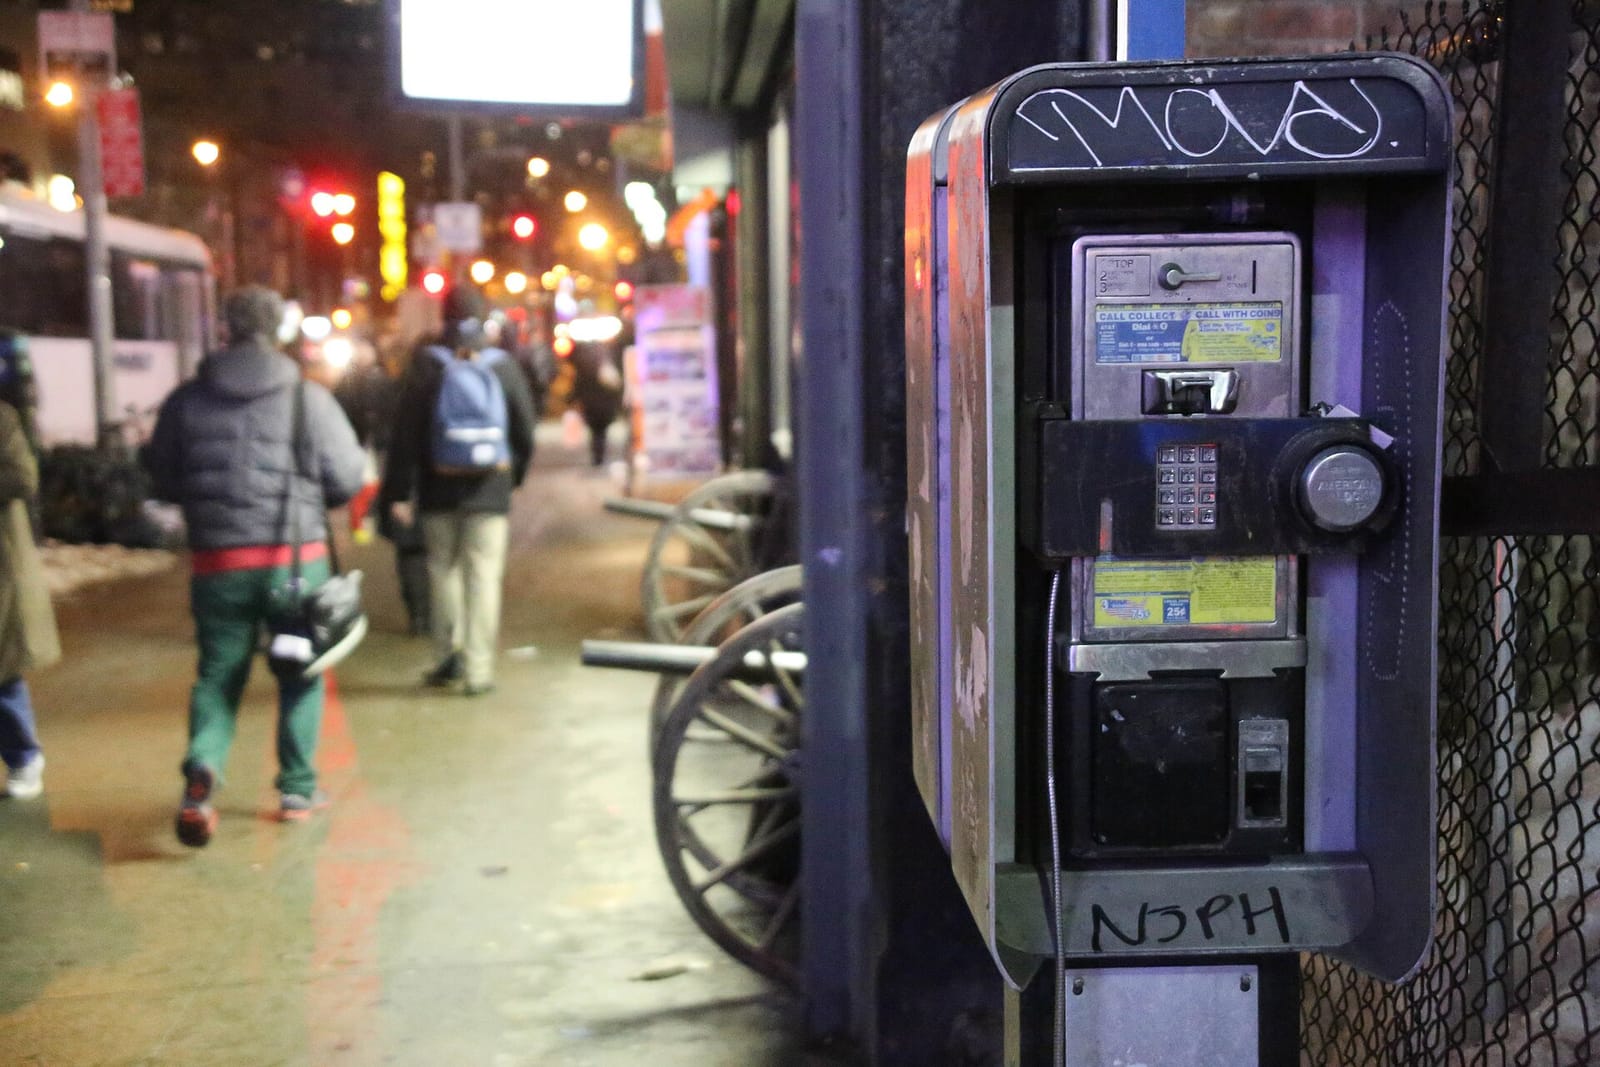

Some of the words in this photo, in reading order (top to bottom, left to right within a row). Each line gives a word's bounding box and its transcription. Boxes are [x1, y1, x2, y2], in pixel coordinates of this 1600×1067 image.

[1100, 270, 1107, 281] 2
[1100, 312, 1126, 321] CALL
[1128, 311, 1176, 320] COLLECT
[1195, 310, 1220, 319] CALL
[1222, 310, 1248, 318] WITH
[1249, 309, 1281, 318] COINS
[1131, 323, 1151, 331] Dial
[1166, 606, 1186, 617] 25¢
